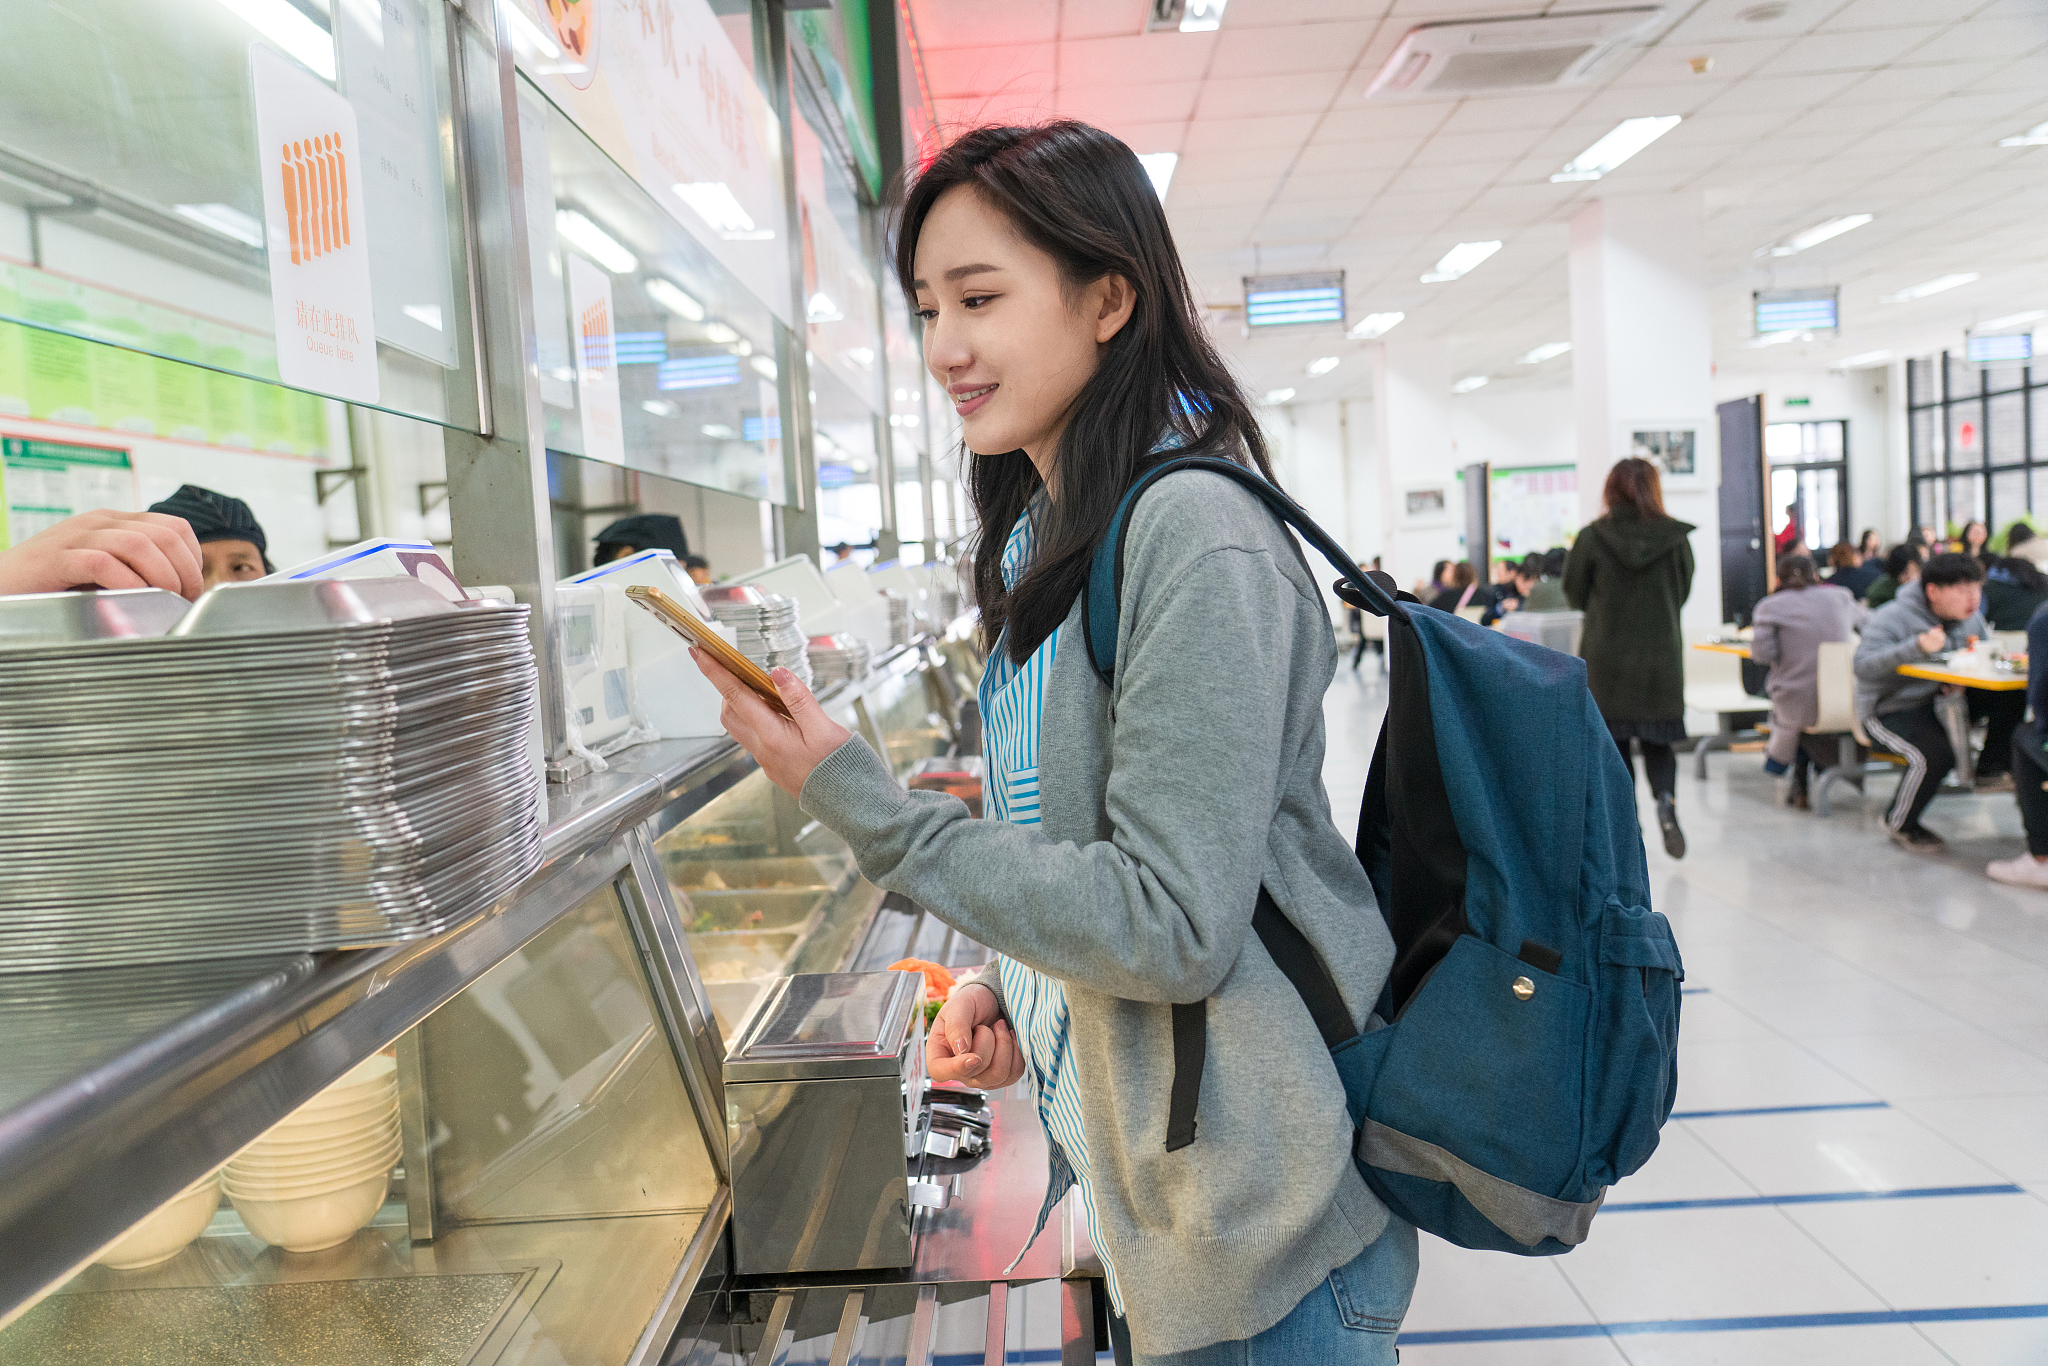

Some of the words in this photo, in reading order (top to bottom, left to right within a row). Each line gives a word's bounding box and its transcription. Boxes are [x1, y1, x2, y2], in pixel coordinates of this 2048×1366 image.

[295, 299, 360, 345] 请在此排队
[306, 335, 334, 357] Queue
[336, 344, 354, 363] here
